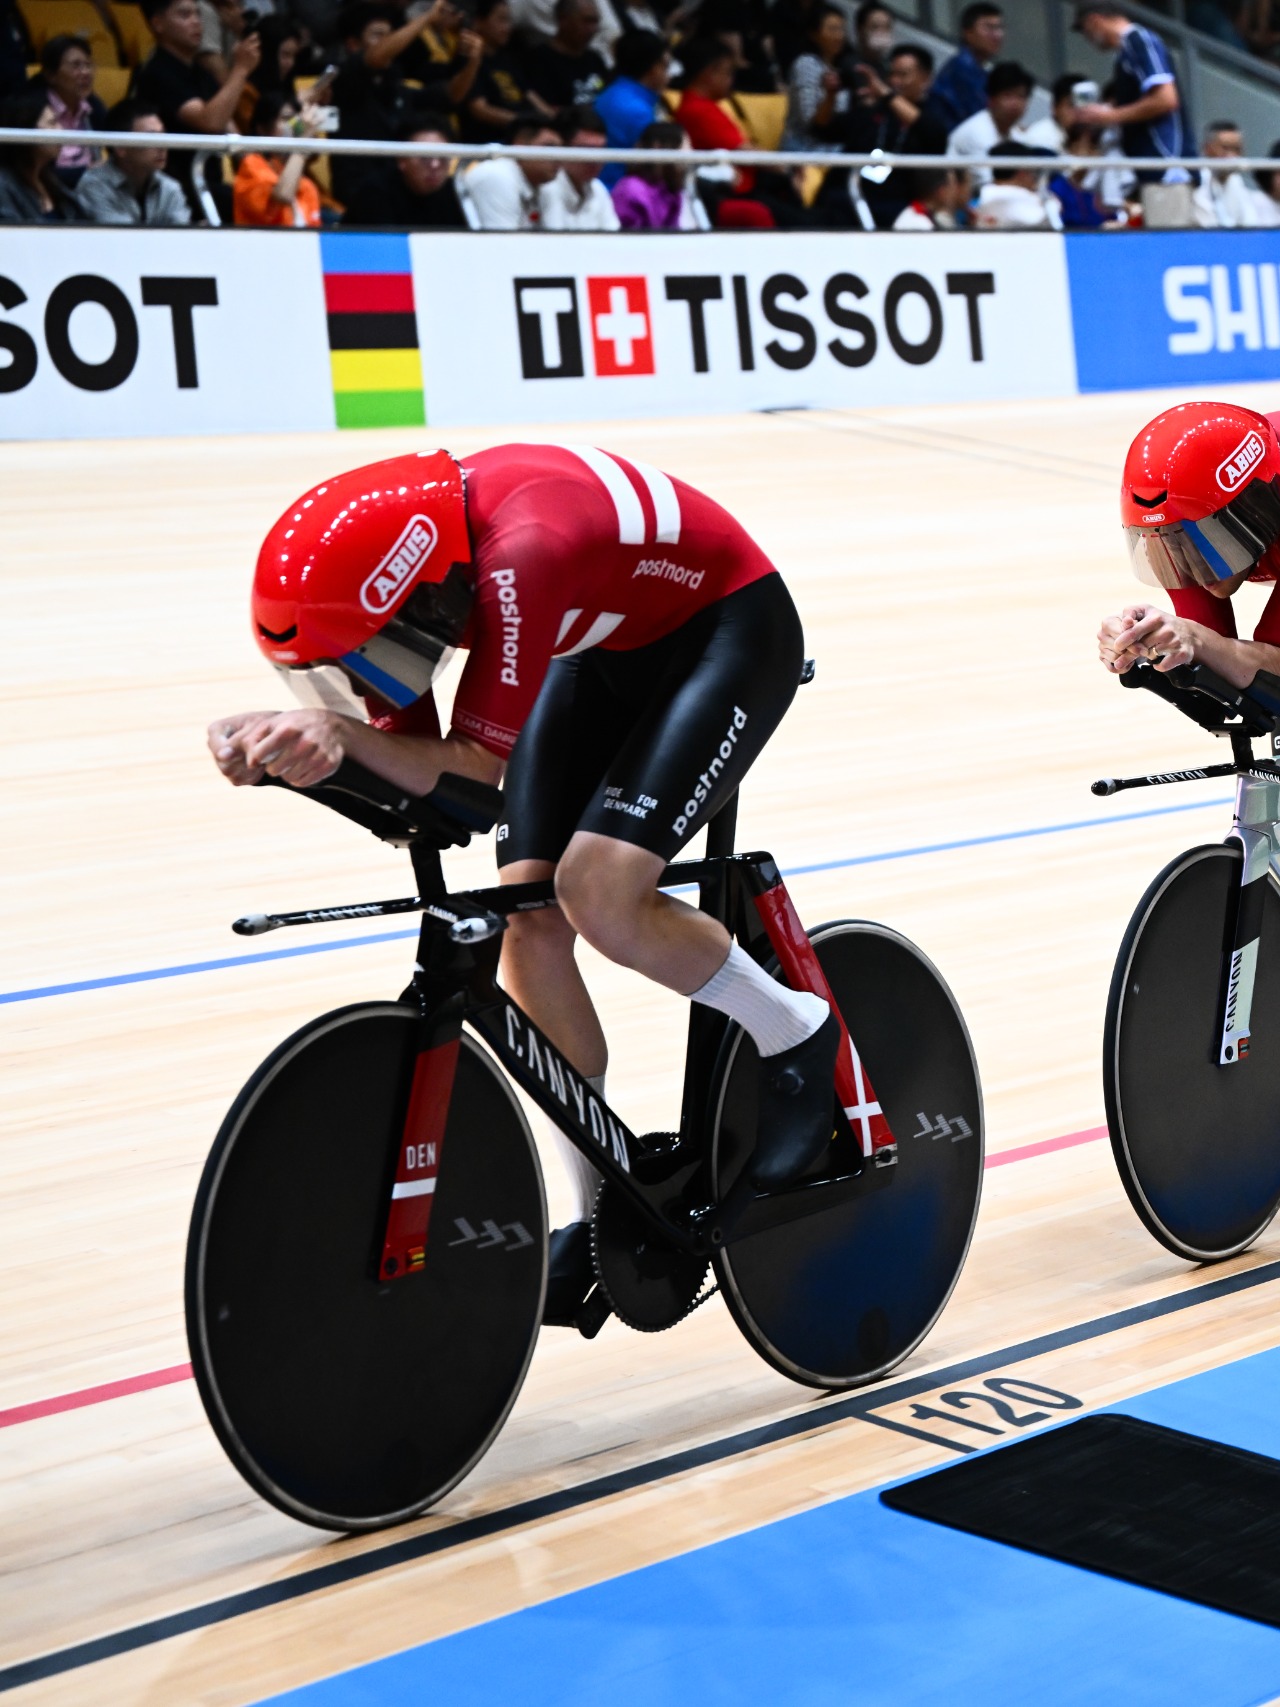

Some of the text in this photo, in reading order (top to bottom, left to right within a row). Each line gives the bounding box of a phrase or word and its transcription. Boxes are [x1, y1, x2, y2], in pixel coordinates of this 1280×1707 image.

[664, 271, 996, 373] TISSOT
[1225, 436, 1262, 485] ABUS
[373, 523, 432, 602] ABUS
[632, 558, 705, 590] postnord
[491, 568, 522, 686] postnord
[672, 705, 748, 836] postnord
[1146, 770, 1208, 785] CANYON
[1249, 769, 1280, 784] CANYON
[603, 798, 650, 819] DENMARK
[604, 786, 659, 810] RIDE FOR
[1225, 951, 1244, 1032] CANYON
[506, 1004, 631, 1174] CANYON
[406, 1141, 437, 1170] DEN
[908, 1377, 1084, 1436] 120
